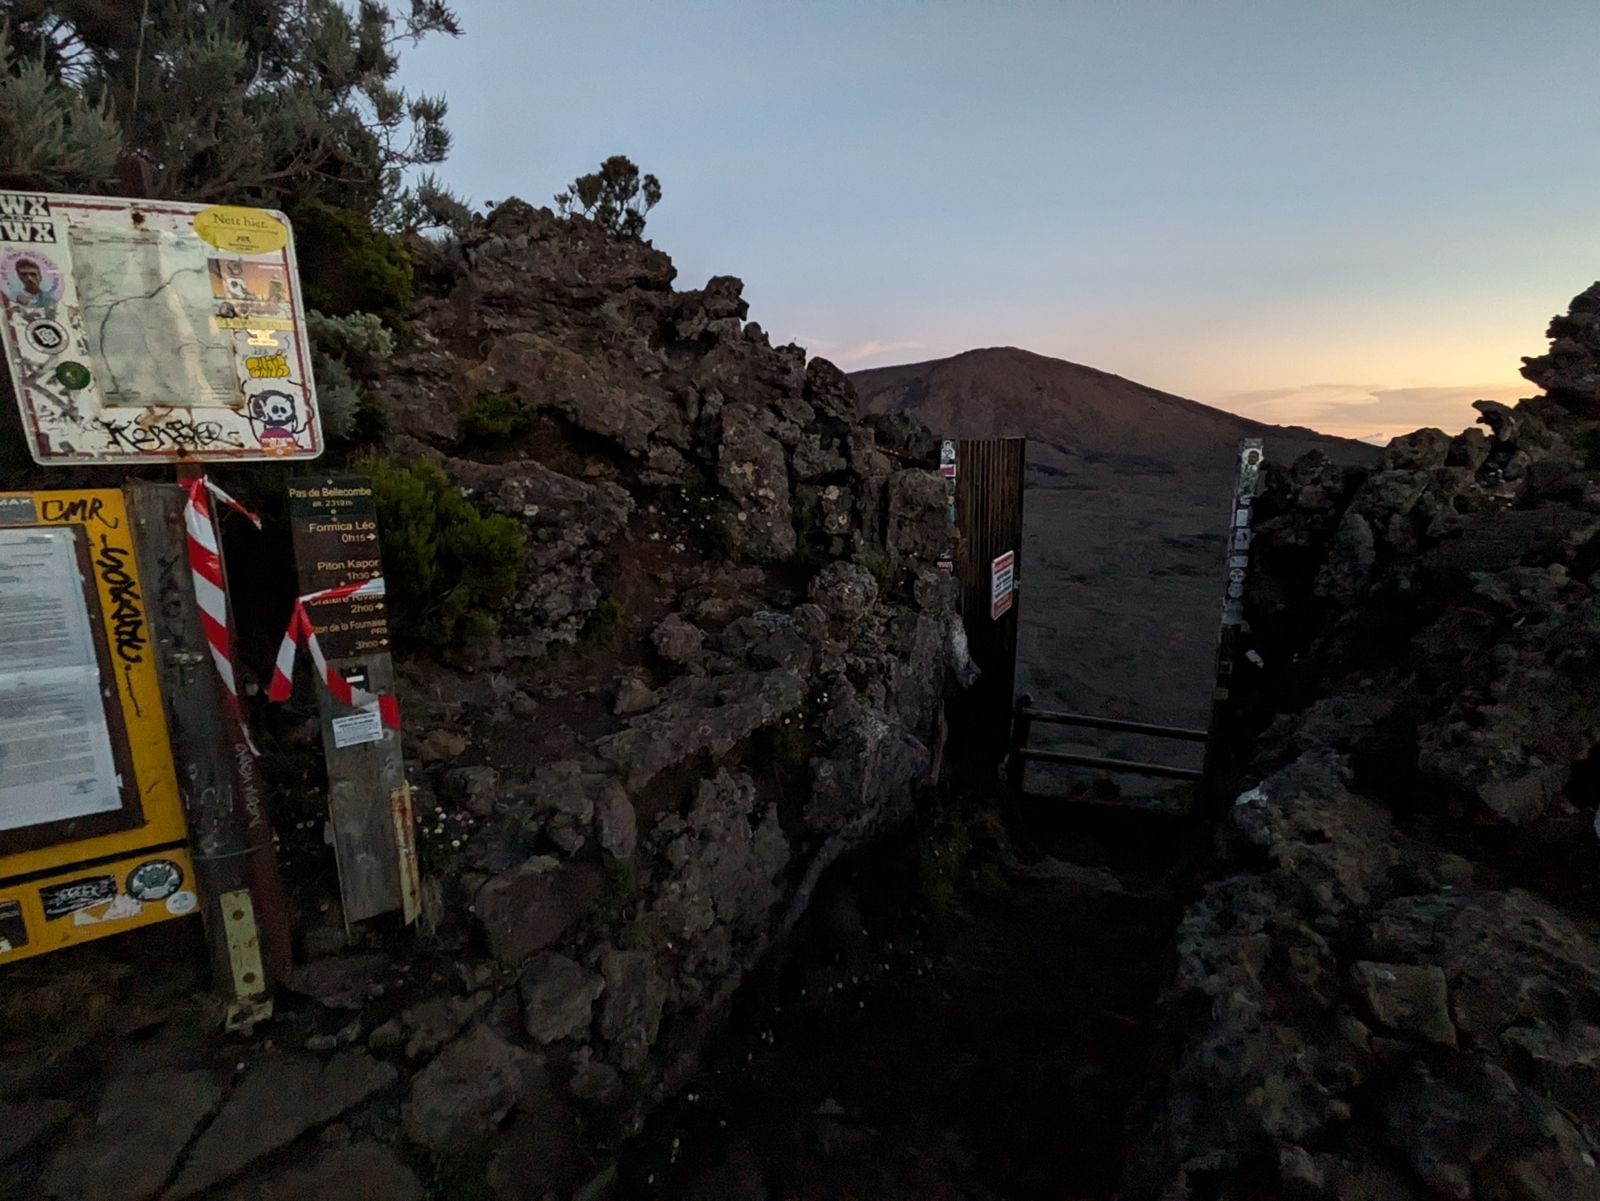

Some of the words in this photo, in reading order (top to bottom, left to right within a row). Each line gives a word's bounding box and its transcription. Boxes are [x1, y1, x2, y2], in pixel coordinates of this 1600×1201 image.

[213, 213, 241, 226] Nett
[0, 221, 56, 243] WX
[288, 488, 307, 499] Pas
[308, 488, 320, 498] de
[321, 487, 372, 498] Bellecombe
[0, 497, 33, 506] AX
[308, 522, 353, 534] Formica
[355, 521, 376, 531] Léo
[341, 533, 367, 543] 0h15
[317, 561, 345, 571] Piton
[347, 559, 379, 569] Kapor
[351, 603, 375, 614] 2h00
